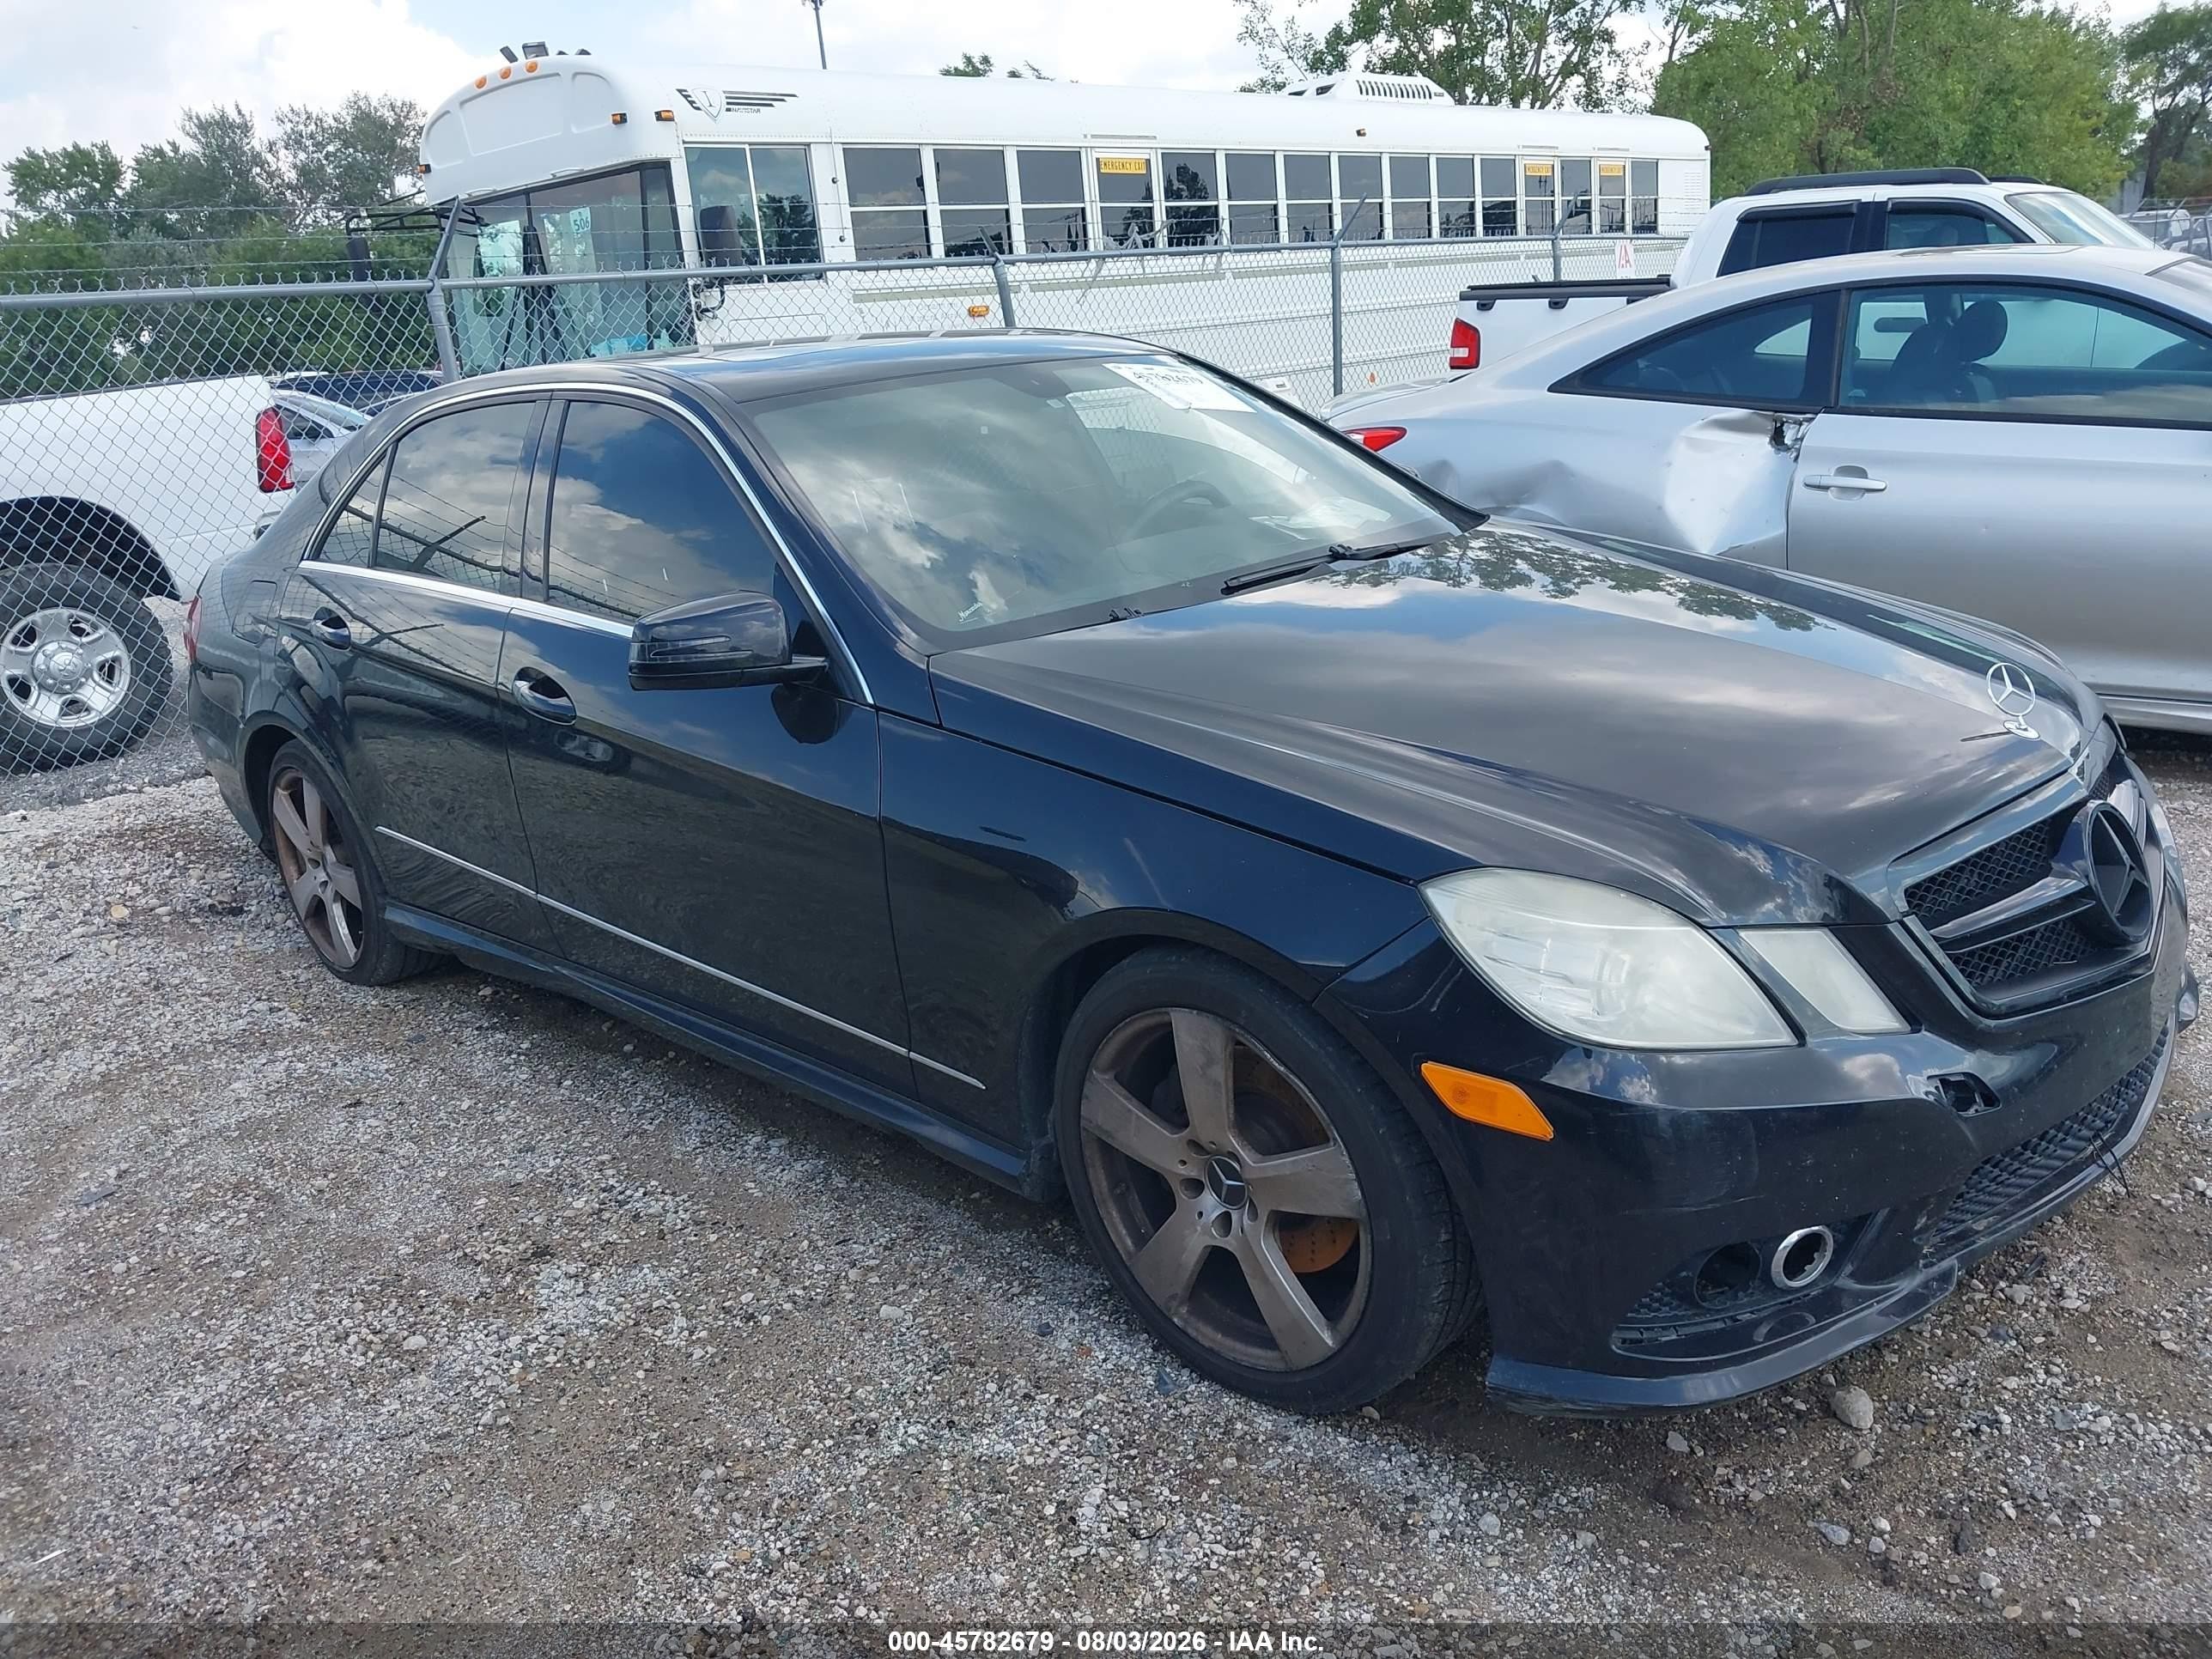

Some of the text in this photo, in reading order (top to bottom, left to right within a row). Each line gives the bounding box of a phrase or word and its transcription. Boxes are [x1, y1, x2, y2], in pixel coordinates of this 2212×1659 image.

[1100, 160, 1146, 171] EMERGENCY EXIT
[573, 216, 590, 231] 506
